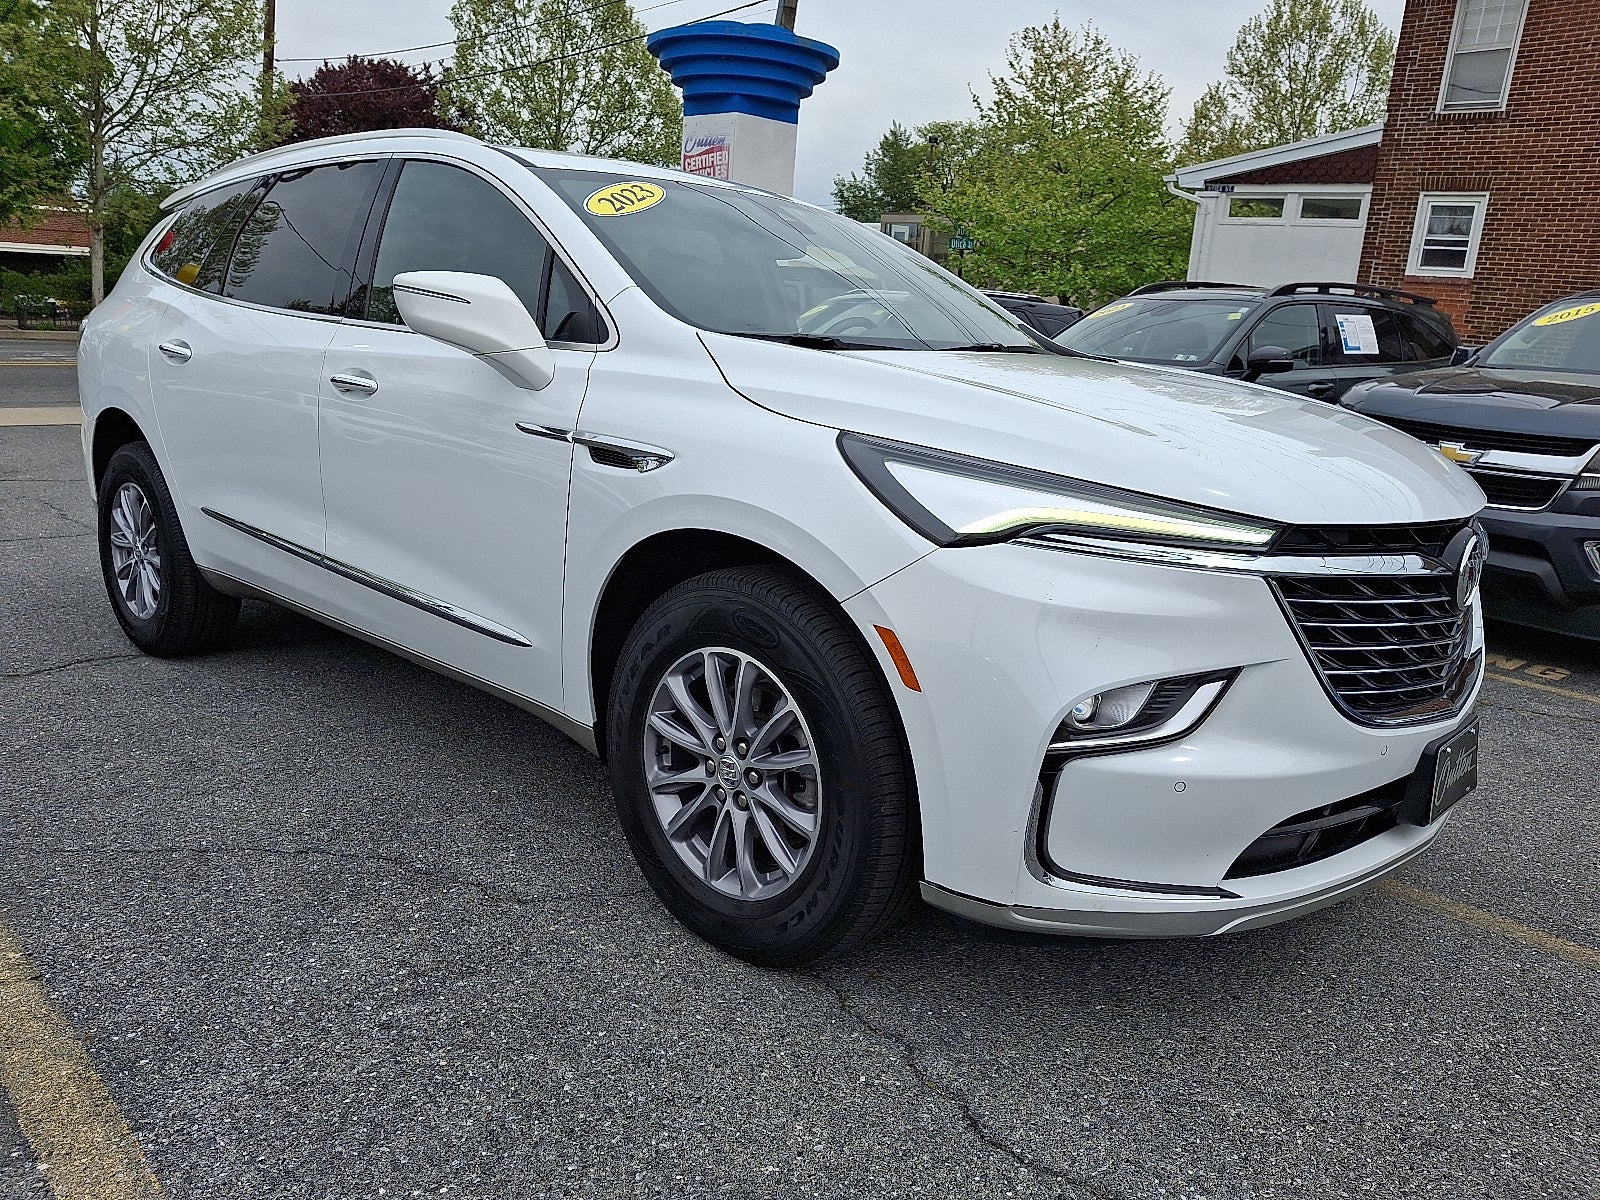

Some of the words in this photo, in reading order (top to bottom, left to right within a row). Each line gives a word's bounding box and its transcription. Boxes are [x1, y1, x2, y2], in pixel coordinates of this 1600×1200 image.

[684, 150, 728, 171] CERTIFIED
[597, 185, 655, 212] 2023
[1546, 305, 1595, 323] 2015
